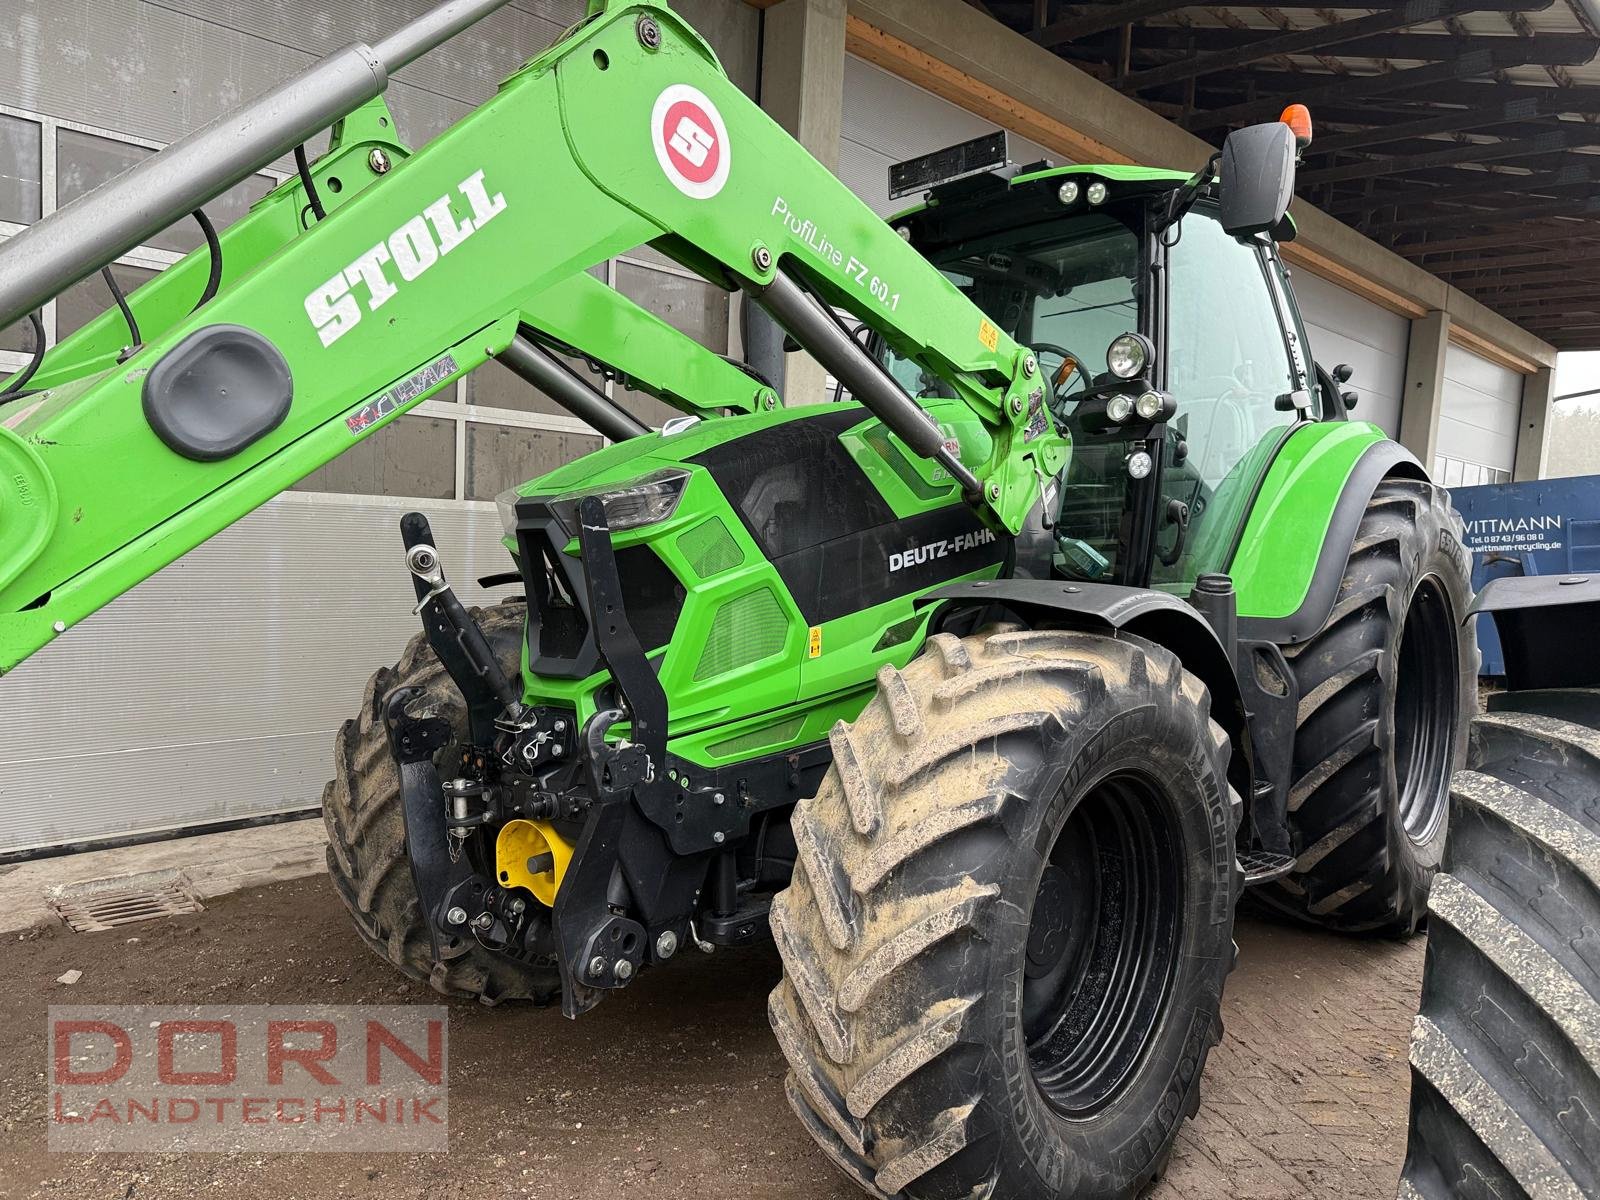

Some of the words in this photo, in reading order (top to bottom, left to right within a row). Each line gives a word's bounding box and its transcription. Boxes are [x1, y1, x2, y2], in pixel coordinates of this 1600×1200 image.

[304, 168, 508, 348] STOLL
[771, 196, 843, 266] ProfiLine
[845, 256, 869, 287] FZ
[869, 275, 901, 312] 60.1
[889, 528, 996, 572] DEUTZ-FAHR
[1470, 536, 1482, 544] Tel.
[1484, 535, 1490, 543] 0
[1490, 535, 1500, 543] 87
[1527, 533, 1537, 541] 08
[1201, 772, 1229, 922] MICHELIN
